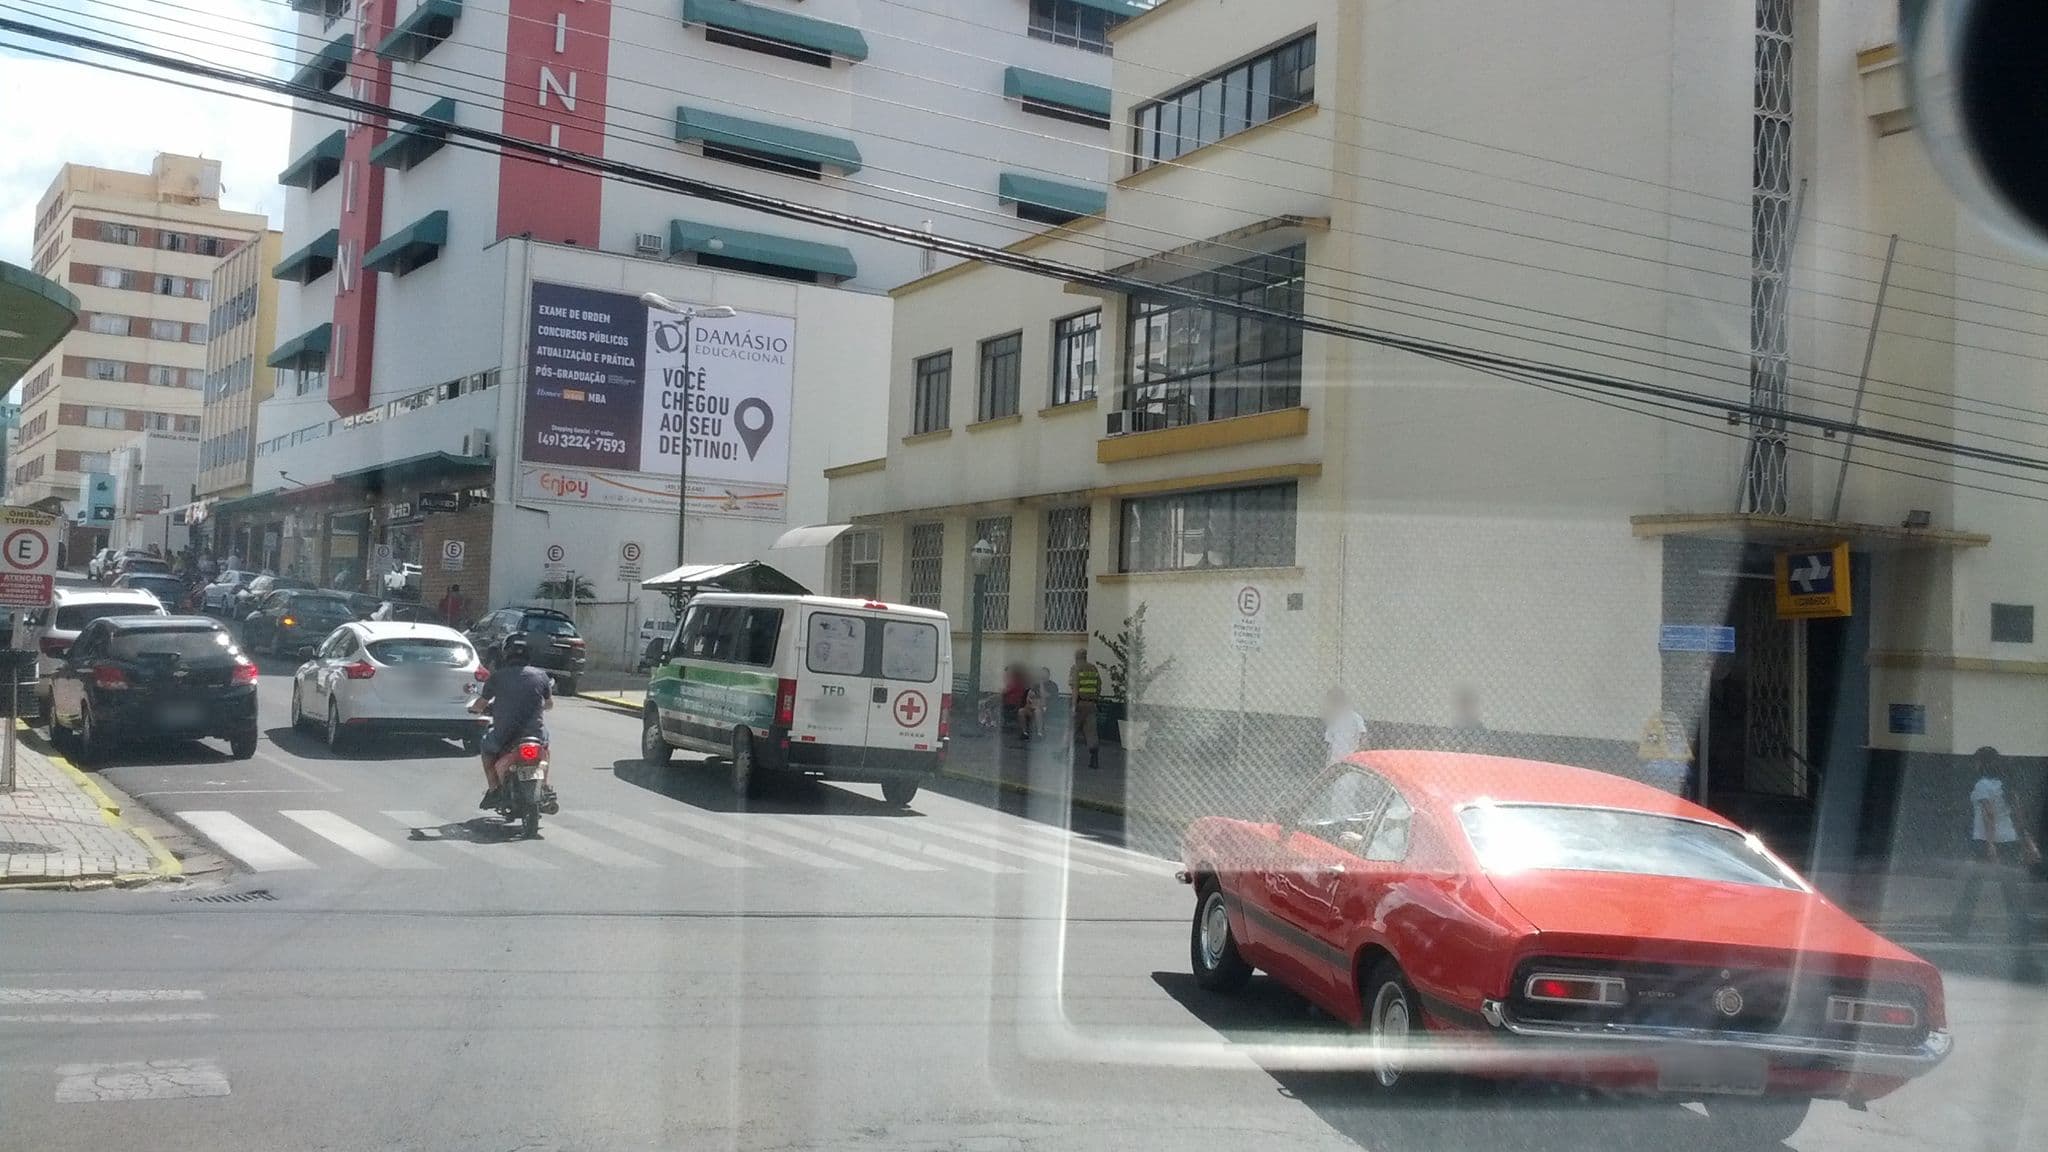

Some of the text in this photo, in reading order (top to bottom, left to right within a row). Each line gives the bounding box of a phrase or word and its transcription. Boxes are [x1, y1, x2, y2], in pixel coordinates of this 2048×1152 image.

[538, 0, 586, 165] INI
[538, 305, 611, 323] EXAME DE ORDEM
[537, 325, 629, 346] CONCURSOS PÚBLICOS
[695, 326, 788, 352] DAMÁSIO
[537, 346, 635, 367] ATUALIZAÇÃO E PRÁTICA
[694, 345, 785, 365] EDUCACIONAL
[535, 364, 606, 384] PÓS-GRADUAÇÃO
[663, 366, 706, 391] VOCÊ
[588, 393, 607, 404] MBA
[661, 391, 729, 416] CHEGOU
[659, 413, 722, 437] AO SEU
[560, 434, 626, 453] 3224-7593
[659, 435, 738, 461] DESTINO!
[540, 473, 589, 498] Enjoy
[19, 540, 32, 559] E
[450, 544, 458, 555] E
[551, 548, 559, 558] E
[627, 546, 635, 557] E
[1244, 593, 1254, 610] E
[821, 685, 845, 697] TFD
